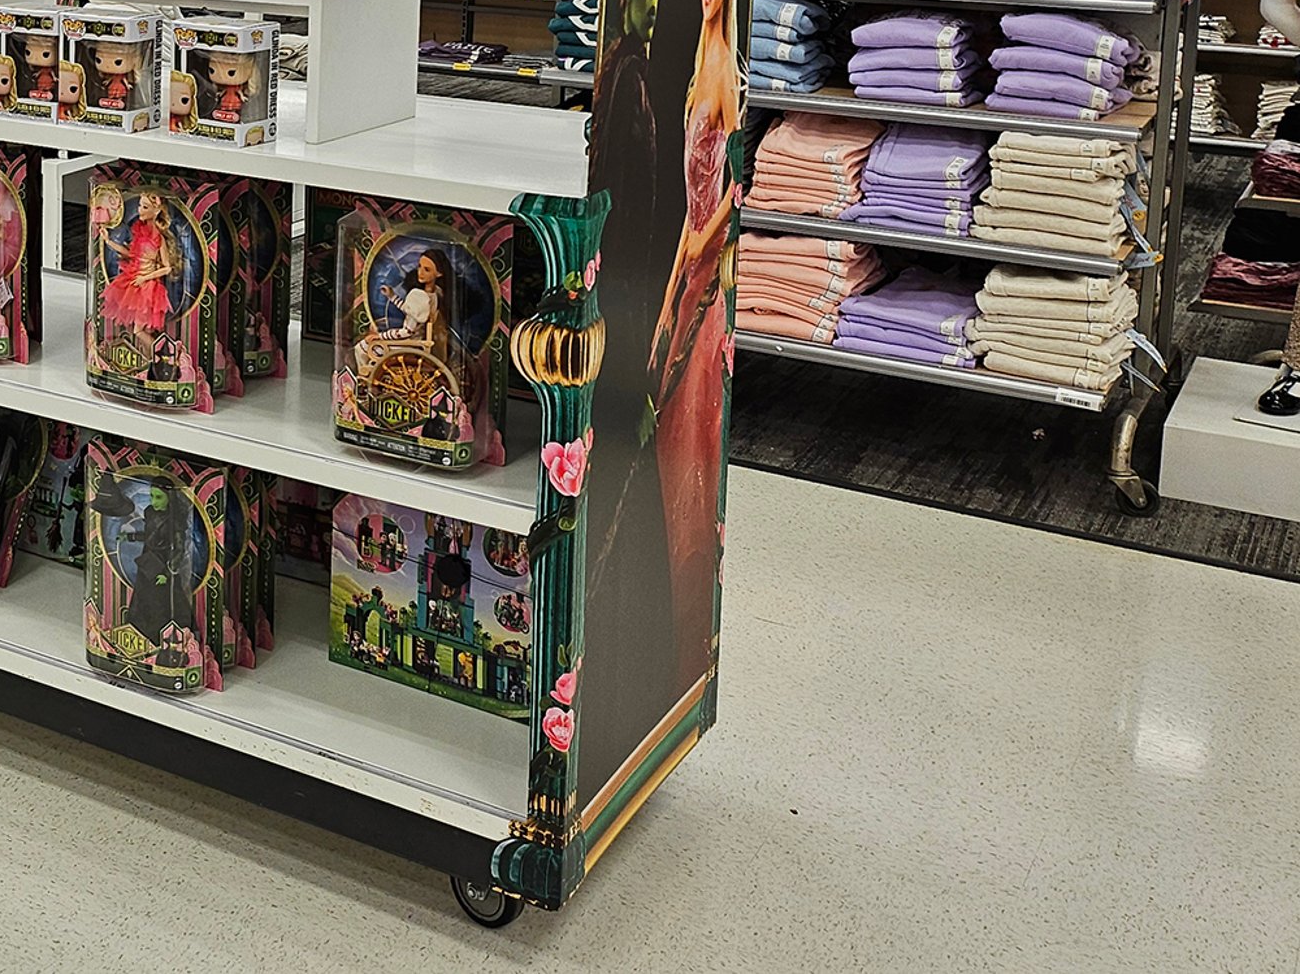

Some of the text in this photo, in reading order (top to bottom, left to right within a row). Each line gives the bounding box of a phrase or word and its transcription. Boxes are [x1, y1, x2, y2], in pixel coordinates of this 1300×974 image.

[154, 62, 162, 78] RED
[269, 73, 278, 91] RED
[268, 91, 278, 119] DRESS
[367, 393, 417, 424] WICKED
